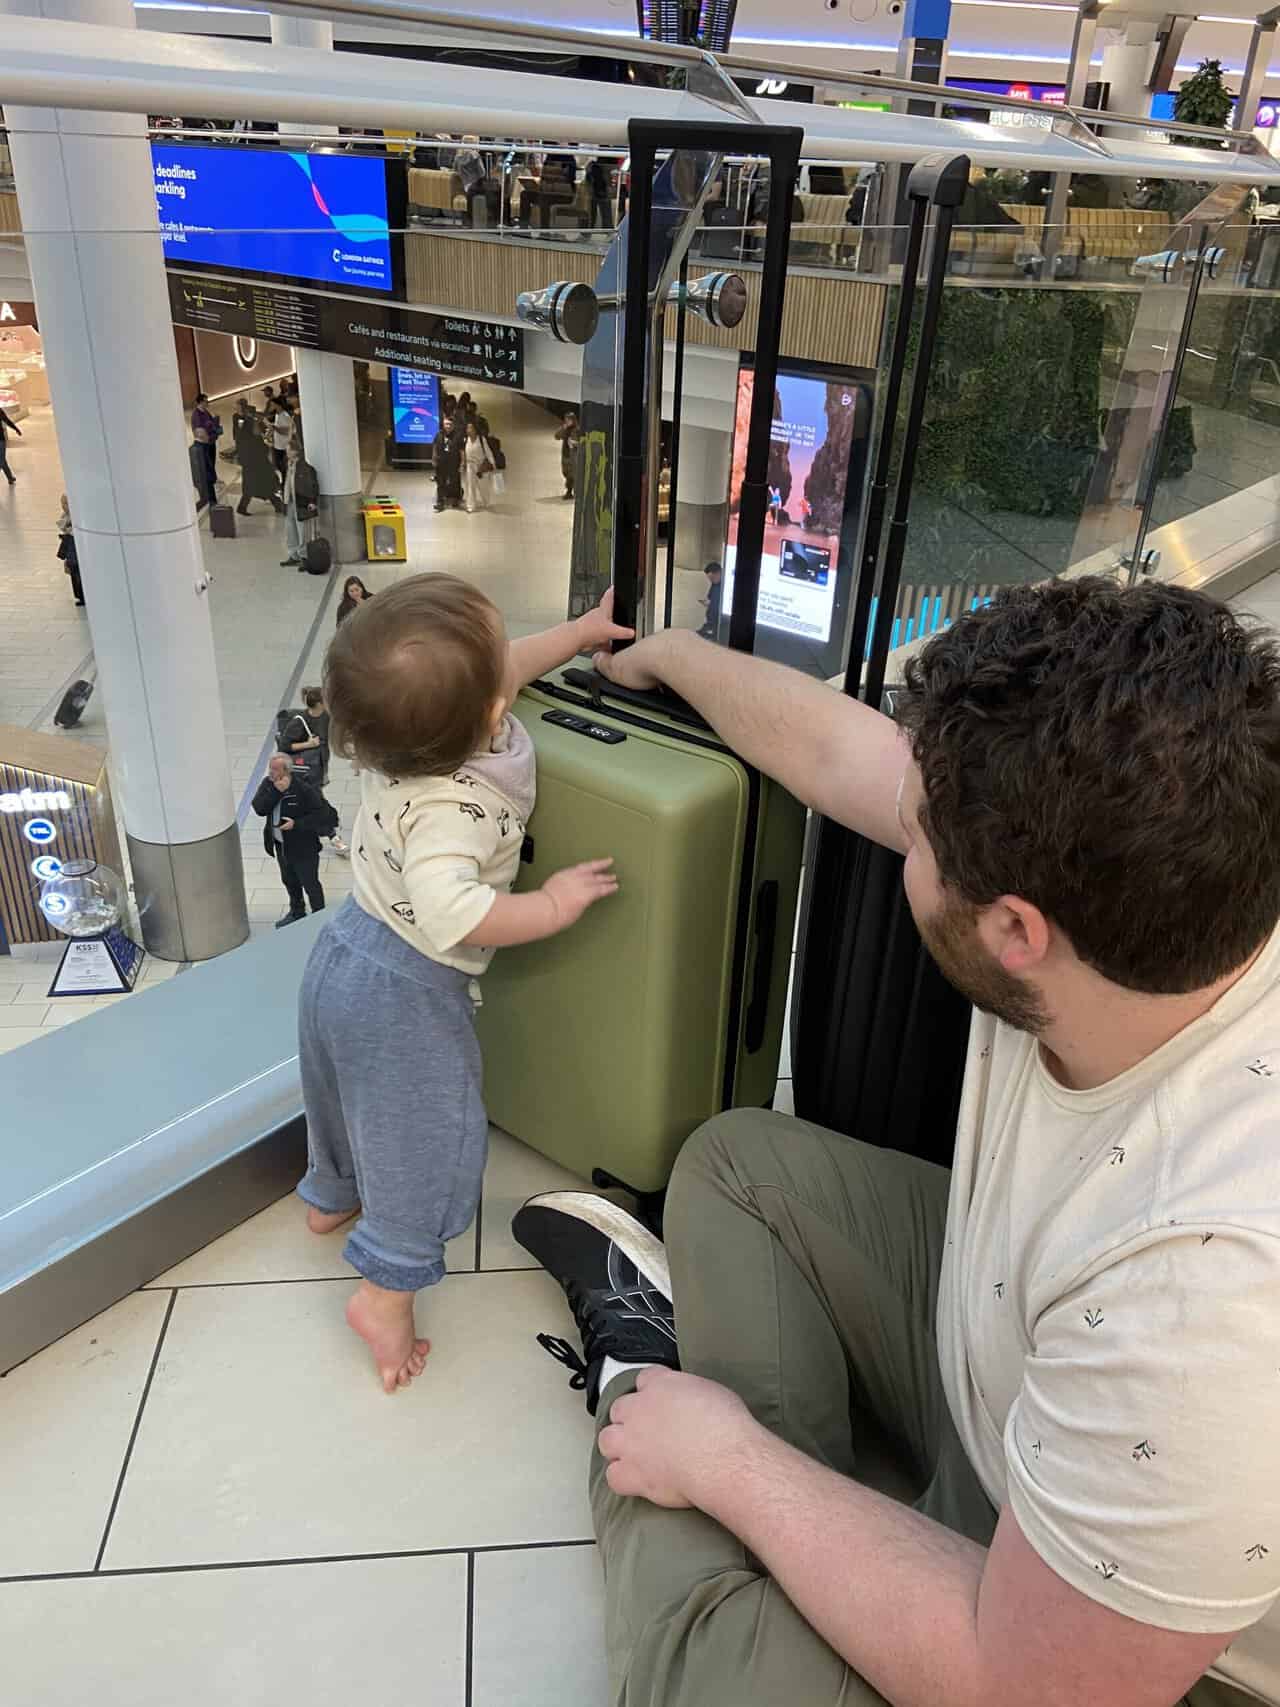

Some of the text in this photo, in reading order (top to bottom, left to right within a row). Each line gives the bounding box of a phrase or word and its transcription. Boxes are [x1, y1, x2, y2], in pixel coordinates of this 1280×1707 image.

[755, 78, 788, 95] JD
[156, 163, 197, 180] deadlines
[154, 181, 187, 200] arkling
[444, 319, 470, 333] Toilets
[371, 328, 385, 338] and
[386, 331, 429, 346] restaurants
[374, 346, 412, 362] Additional
[413, 355, 442, 370] seating
[0, 787, 71, 813] atm
